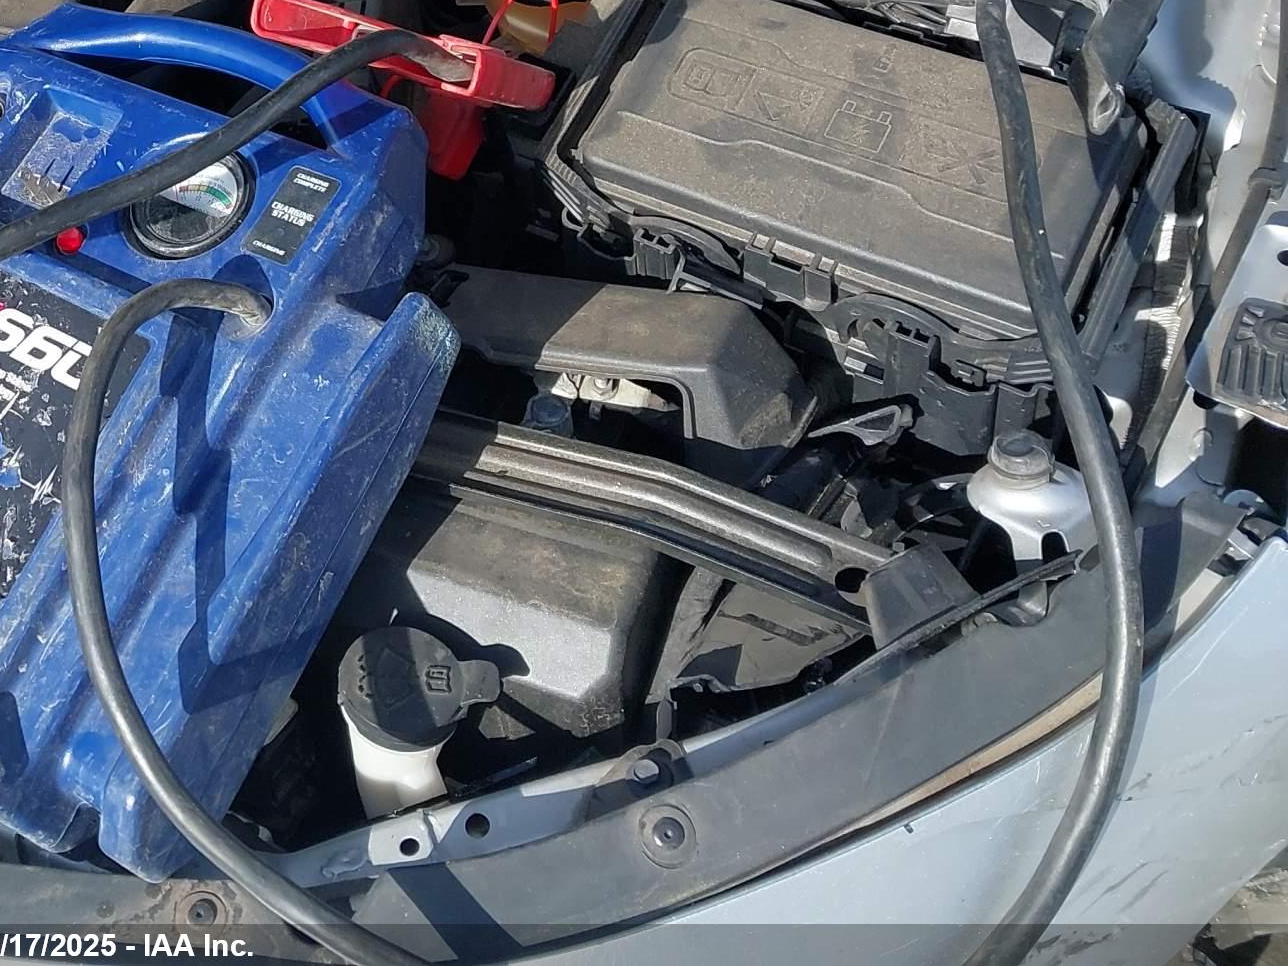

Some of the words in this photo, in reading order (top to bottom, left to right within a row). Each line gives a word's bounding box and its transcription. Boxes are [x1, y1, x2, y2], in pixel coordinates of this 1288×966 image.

[293, 177, 328, 193] COMPLETE
[296, 173, 330, 188] CHARGING
[271, 201, 316, 222] CHARGING
[272, 209, 306, 227] STATUS
[252, 240, 286, 256] CHARGING
